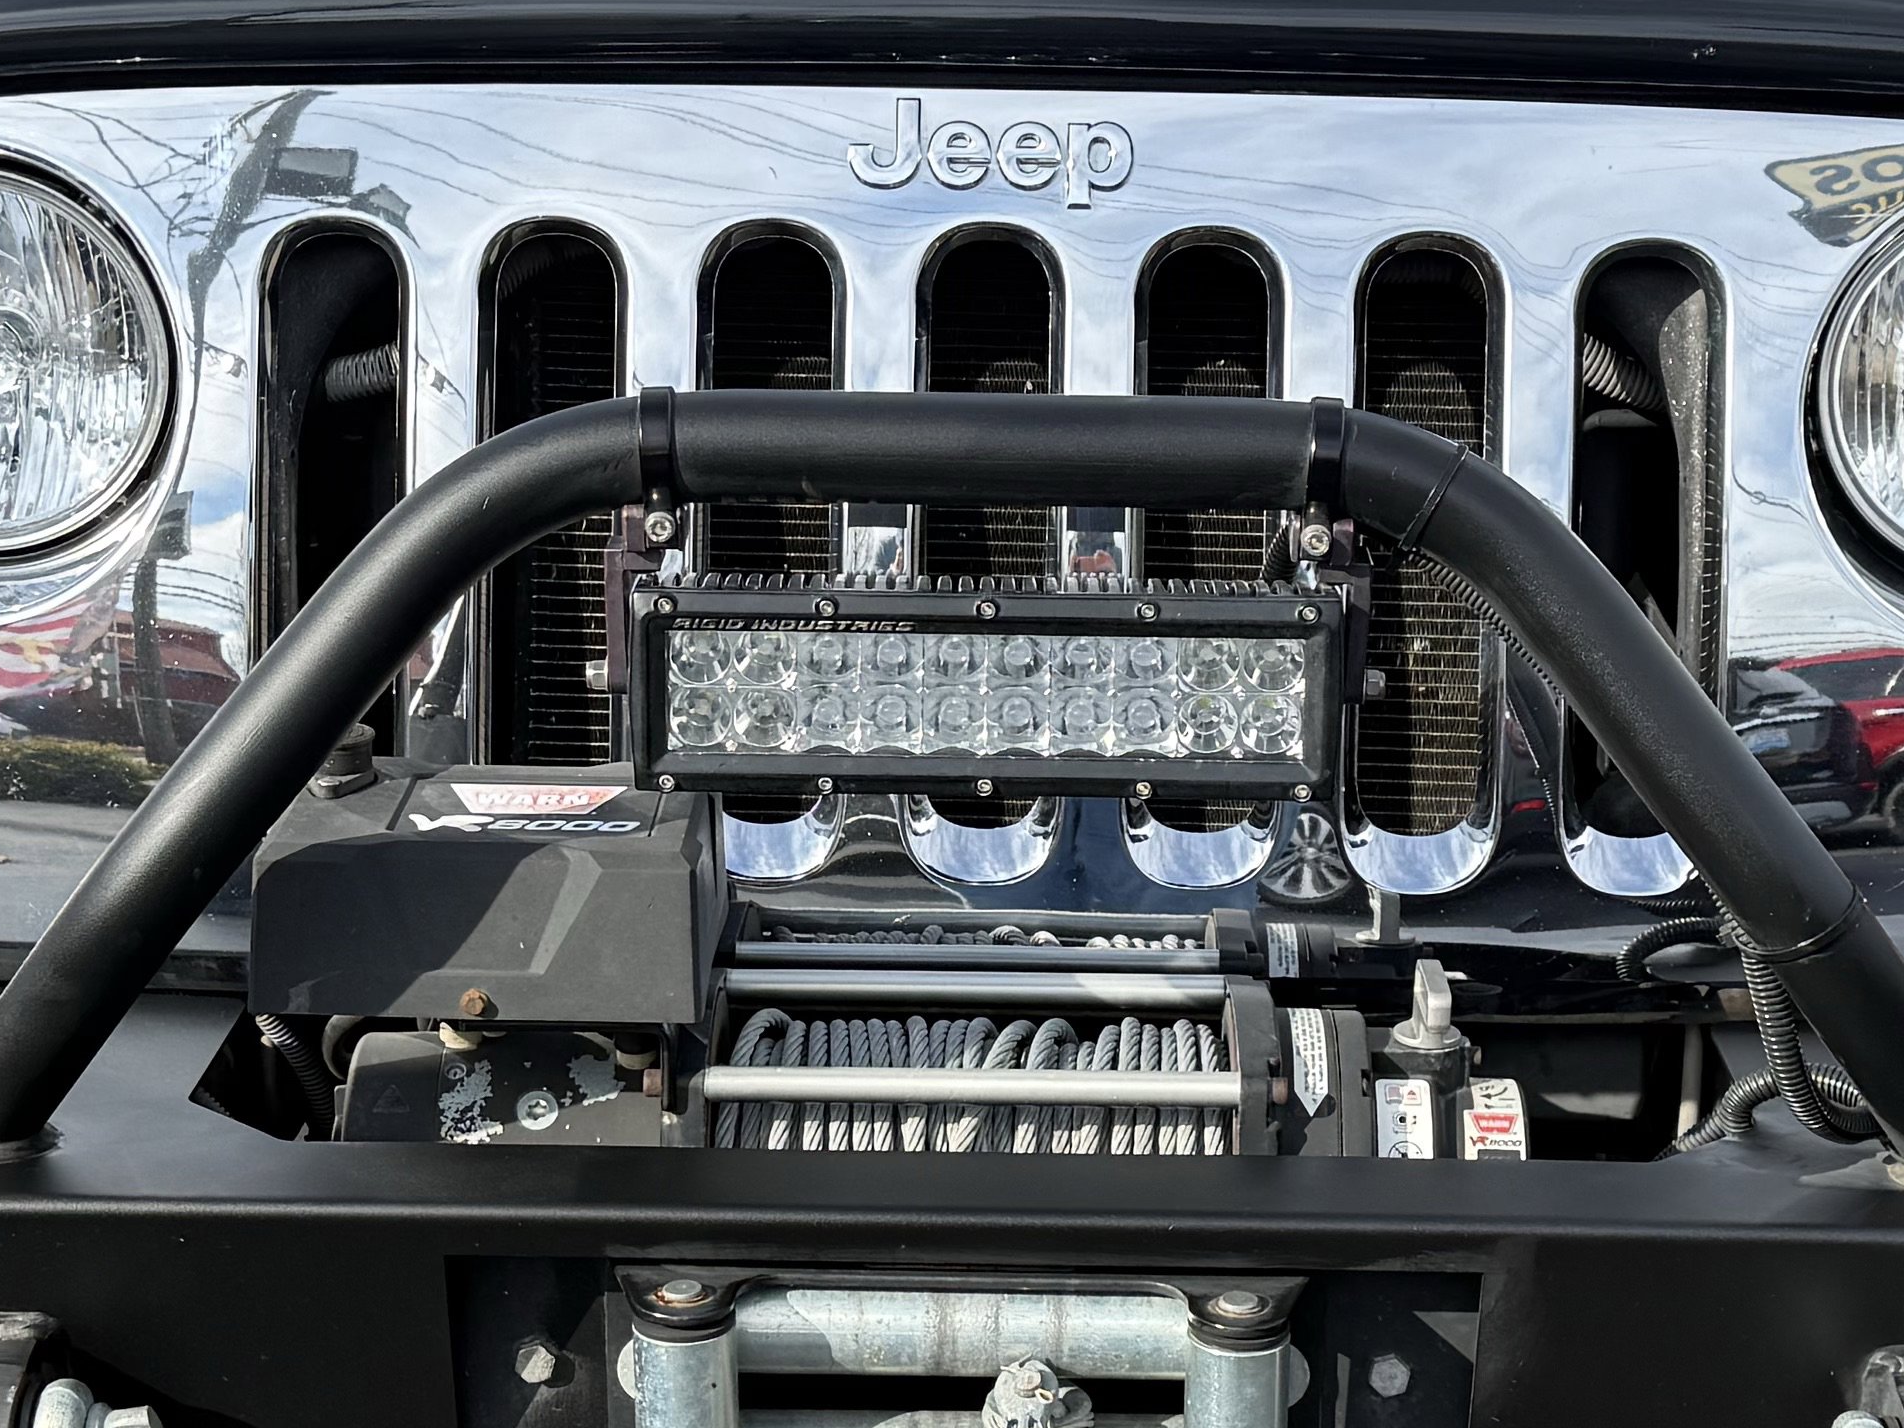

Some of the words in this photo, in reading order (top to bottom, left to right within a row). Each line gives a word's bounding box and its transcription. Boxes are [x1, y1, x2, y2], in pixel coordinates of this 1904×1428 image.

[848, 97, 1134, 210] Jeep
[672, 617, 745, 630] RIGID
[750, 618, 917, 632] INDUSTRIES
[477, 792, 590, 807] WARN
